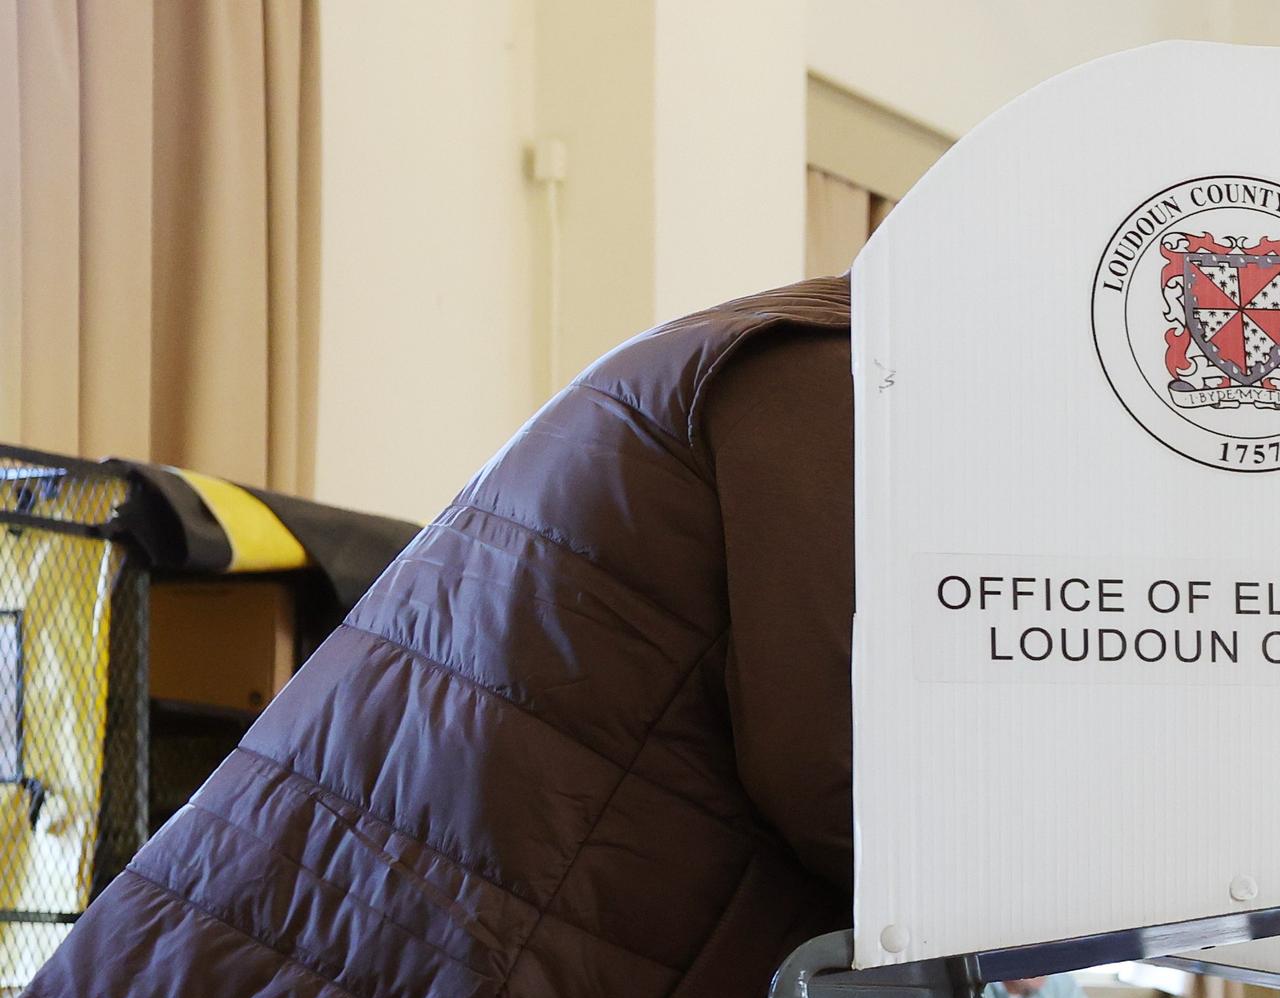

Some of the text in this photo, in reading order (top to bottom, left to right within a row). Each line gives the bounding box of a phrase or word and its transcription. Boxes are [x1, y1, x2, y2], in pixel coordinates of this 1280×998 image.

[1103, 196, 1182, 293] LOUDOUN
[1218, 442, 1280, 464] 1757
[937, 575, 1125, 613] OFFICE
[1147, 580, 1212, 614] OF
[990, 626, 1239, 664] LOUDOUN
